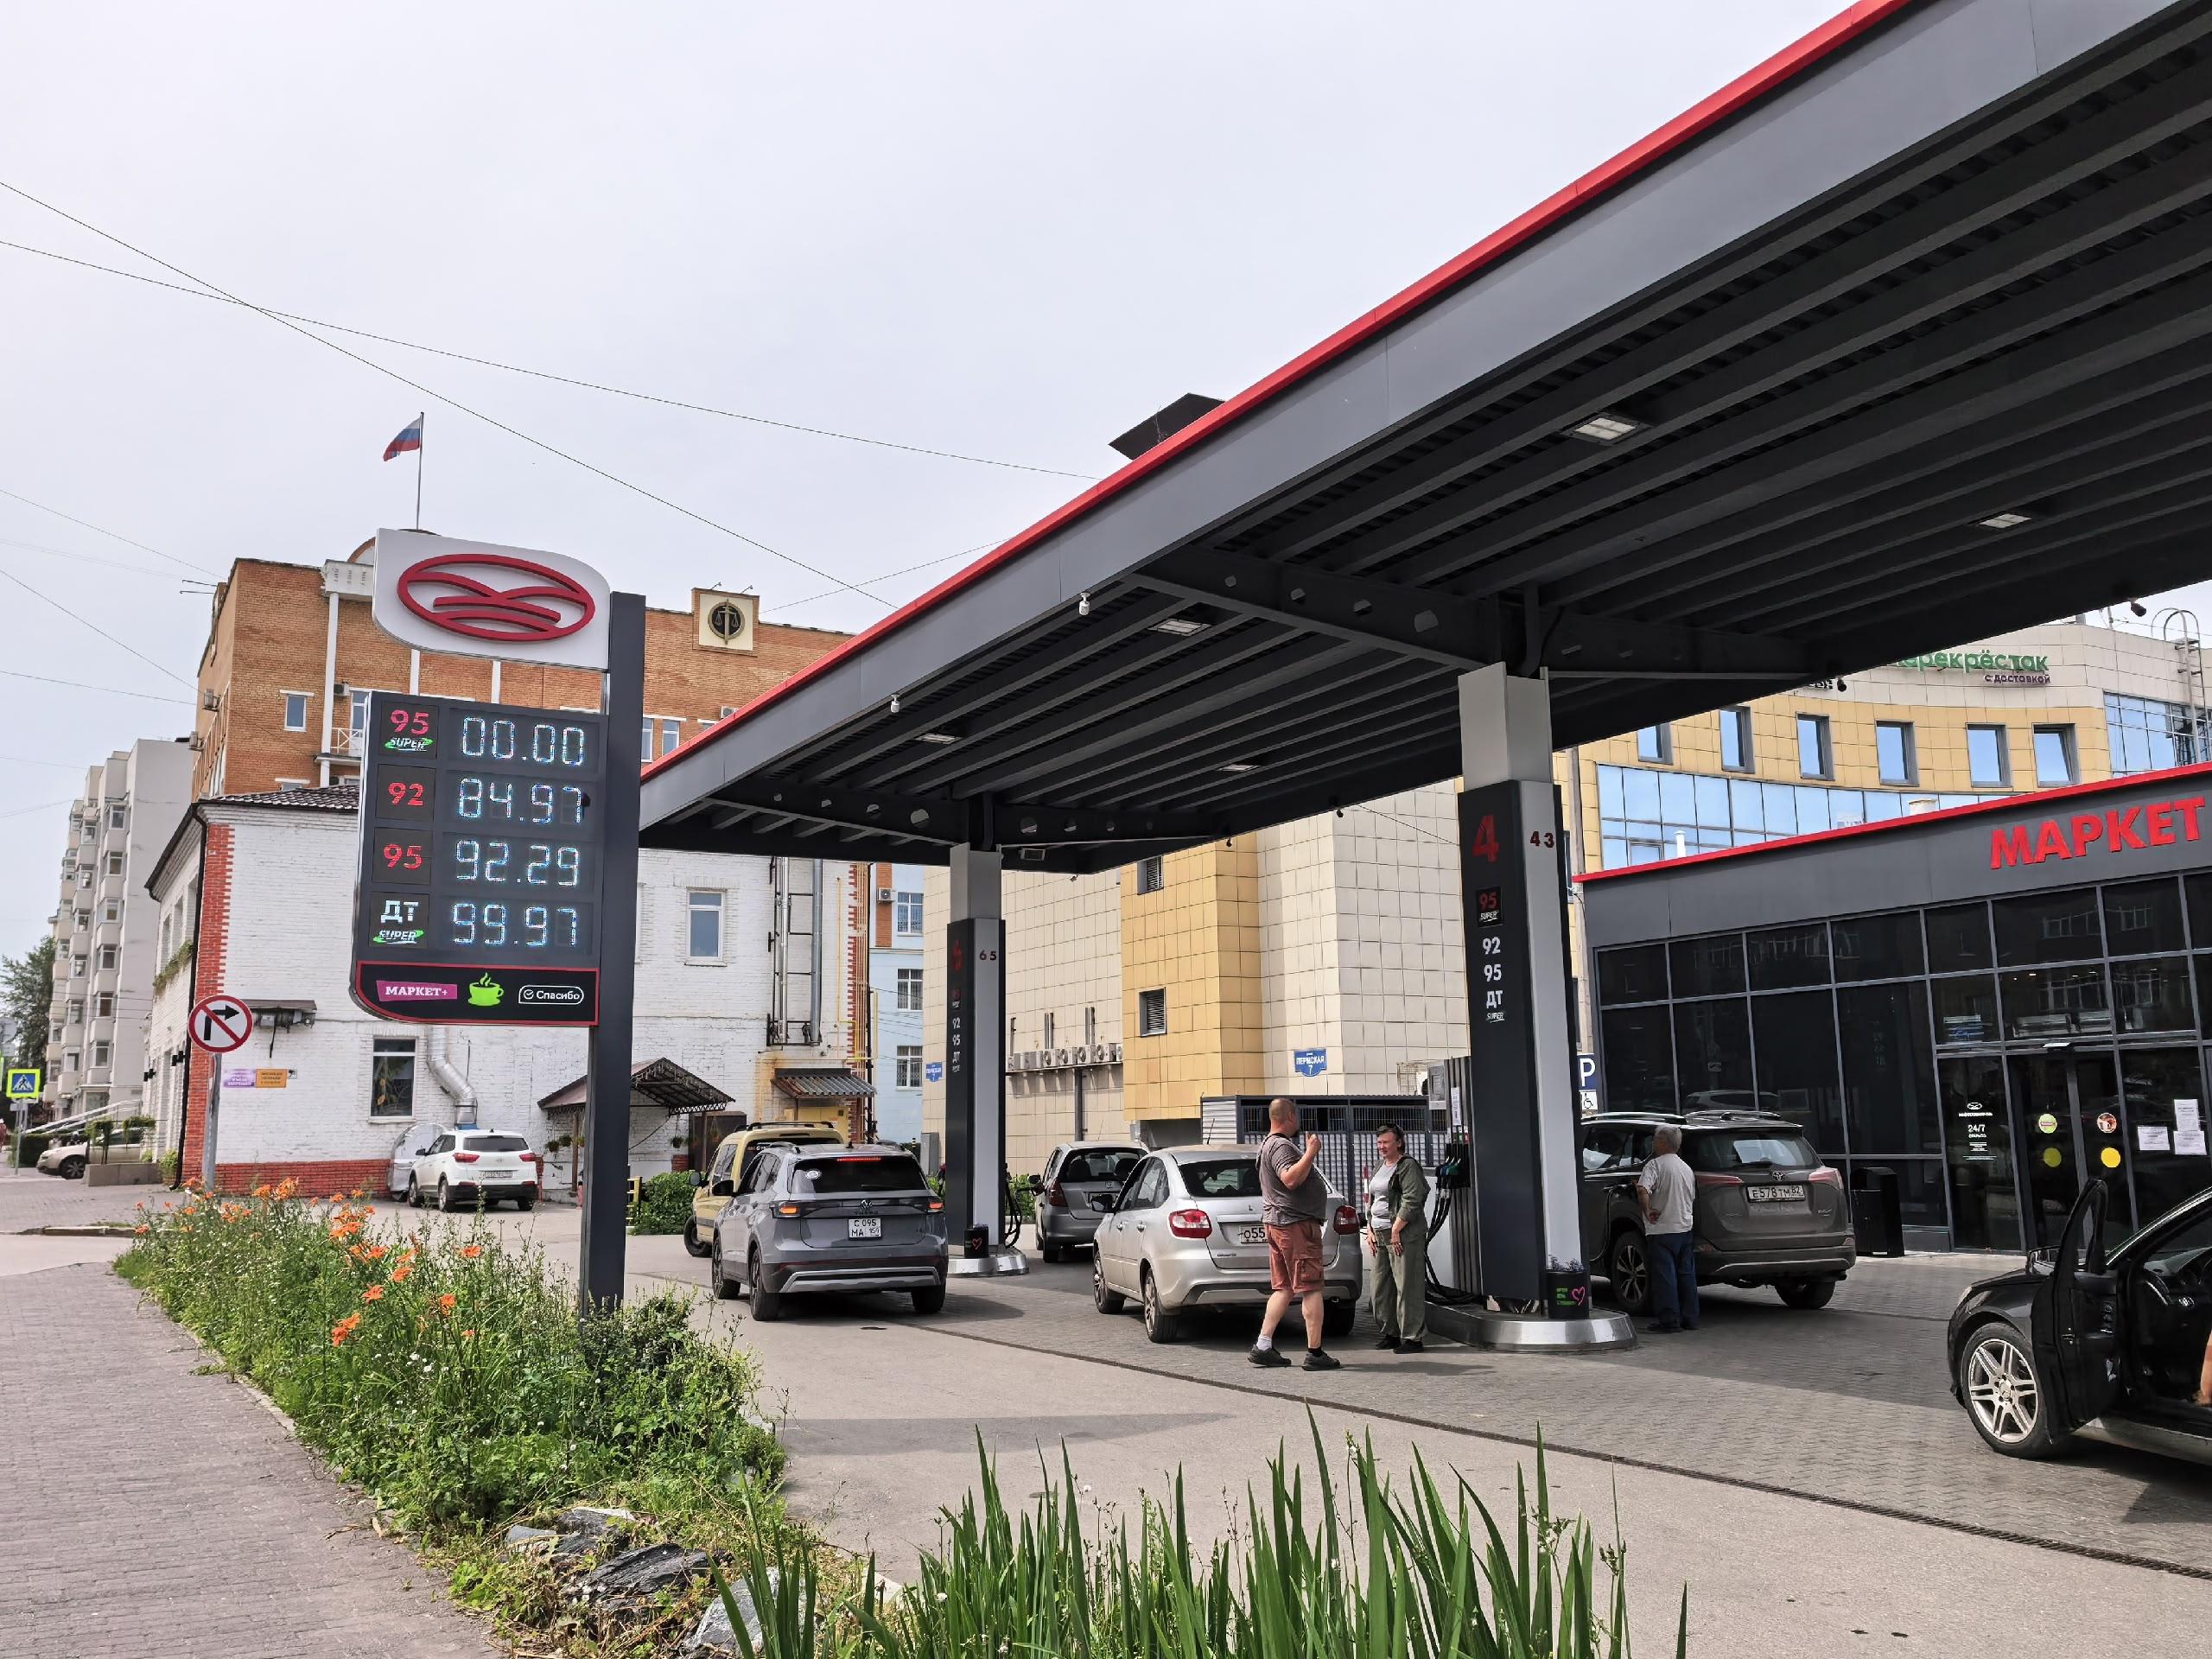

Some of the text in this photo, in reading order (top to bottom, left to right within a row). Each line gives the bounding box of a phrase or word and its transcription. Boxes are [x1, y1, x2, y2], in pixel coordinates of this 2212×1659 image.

[1993, 675, 2050, 684] доставкой
[390, 709, 429, 736] 95
[389, 737, 427, 750] SUPER
[462, 716, 584, 766] 00.00
[387, 781, 425, 807] 92
[459, 778, 582, 824] 84.97
[1471, 815, 1500, 862] 4
[1990, 795, 2206, 870] МАРКЕТ
[383, 843, 423, 870] 95
[456, 839, 579, 887] 92.29
[380, 899, 419, 924] ДТ
[378, 930, 416, 942] SUPER
[452, 903, 576, 946] 99.97
[1482, 936, 1501, 955] 92
[1484, 963, 1502, 982] 95
[385, 986, 448, 997] МАРКЕТ+
[536, 990, 581, 1001] Спасибо
[1485, 989, 1503, 1009] ДТ
[1967, 1123, 1986, 1133] 24/7
